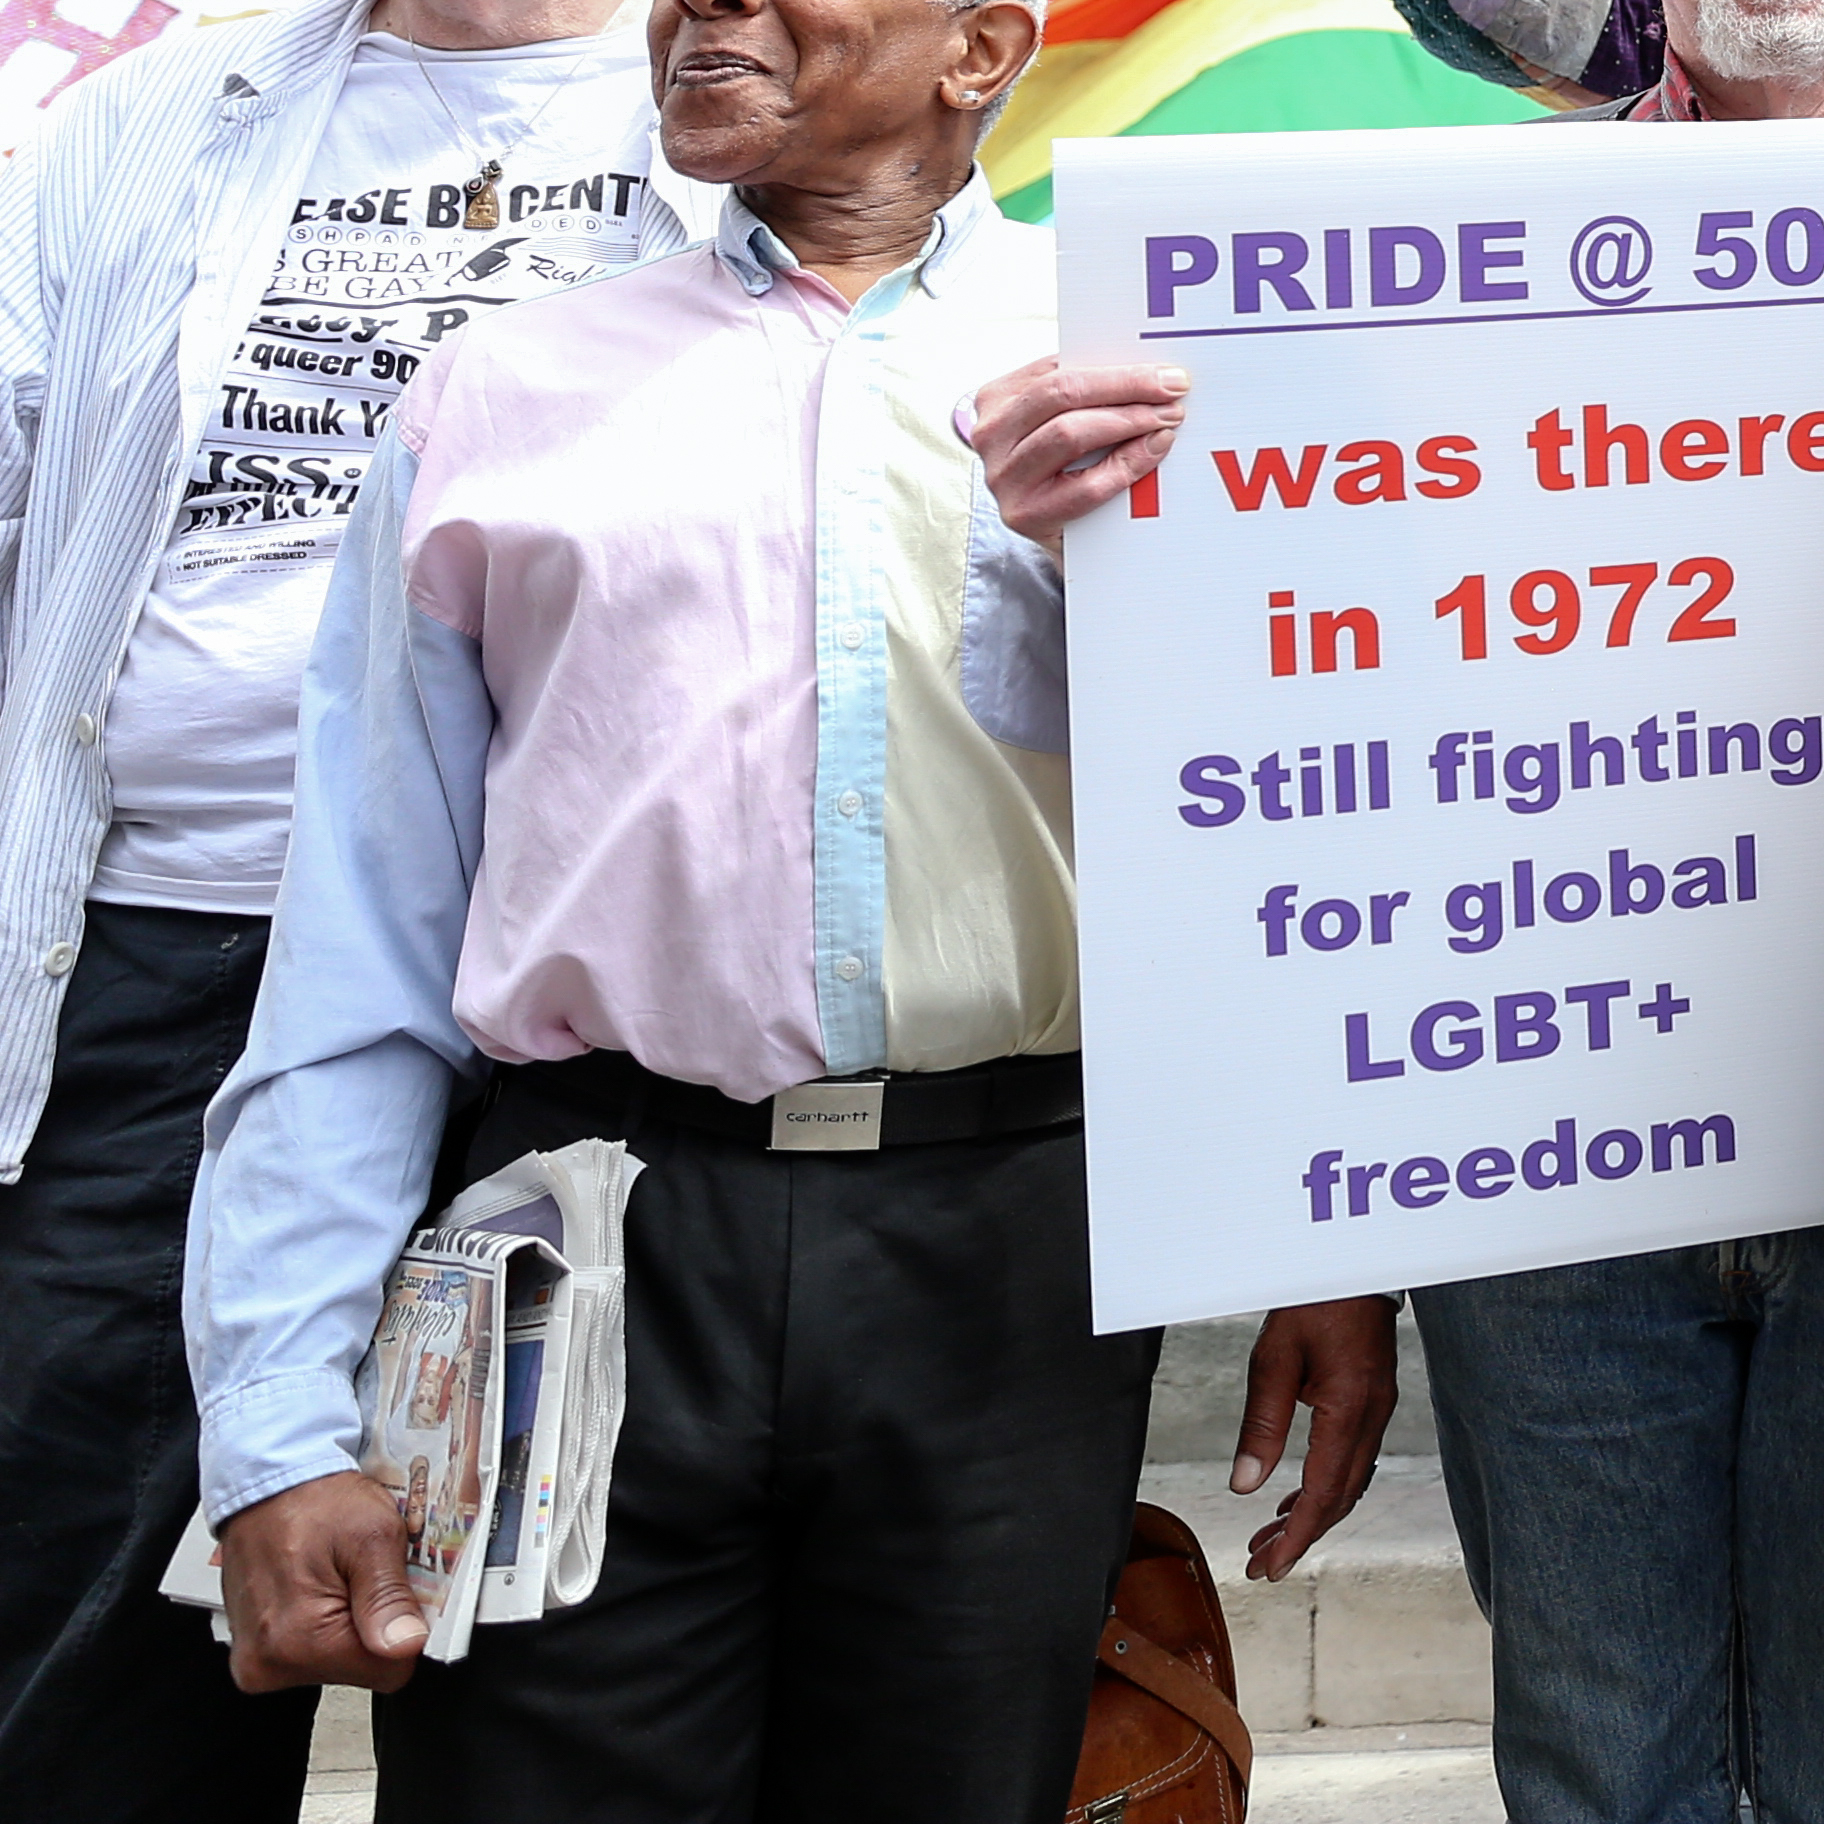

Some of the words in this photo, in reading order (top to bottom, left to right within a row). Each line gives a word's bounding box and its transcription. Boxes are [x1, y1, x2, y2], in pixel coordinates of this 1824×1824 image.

[509, 173, 648, 223] CENT
[302, 249, 464, 274] GREAT
[345, 275, 441, 300] GAY
[1146, 222, 1528, 317] PRIDE
[1570, 216, 1652, 307] @
[251, 343, 363, 376] queer
[222, 384, 345, 436] Thank
[1212, 435, 1482, 512] was
[250, 550, 307, 562] DRESSED
[1269, 591, 1380, 676] in
[1436, 557, 1736, 660] 1972
[1179, 740, 1390, 827] Still
[1430, 711, 1822, 814] fighting
[1258, 885, 1410, 956] for
[1446, 835, 1756, 953] global
[1346, 980, 1690, 1082] LGBT+
[786, 1111, 869, 1123] carhartt
[1302, 1115, 1736, 1222] freedom
